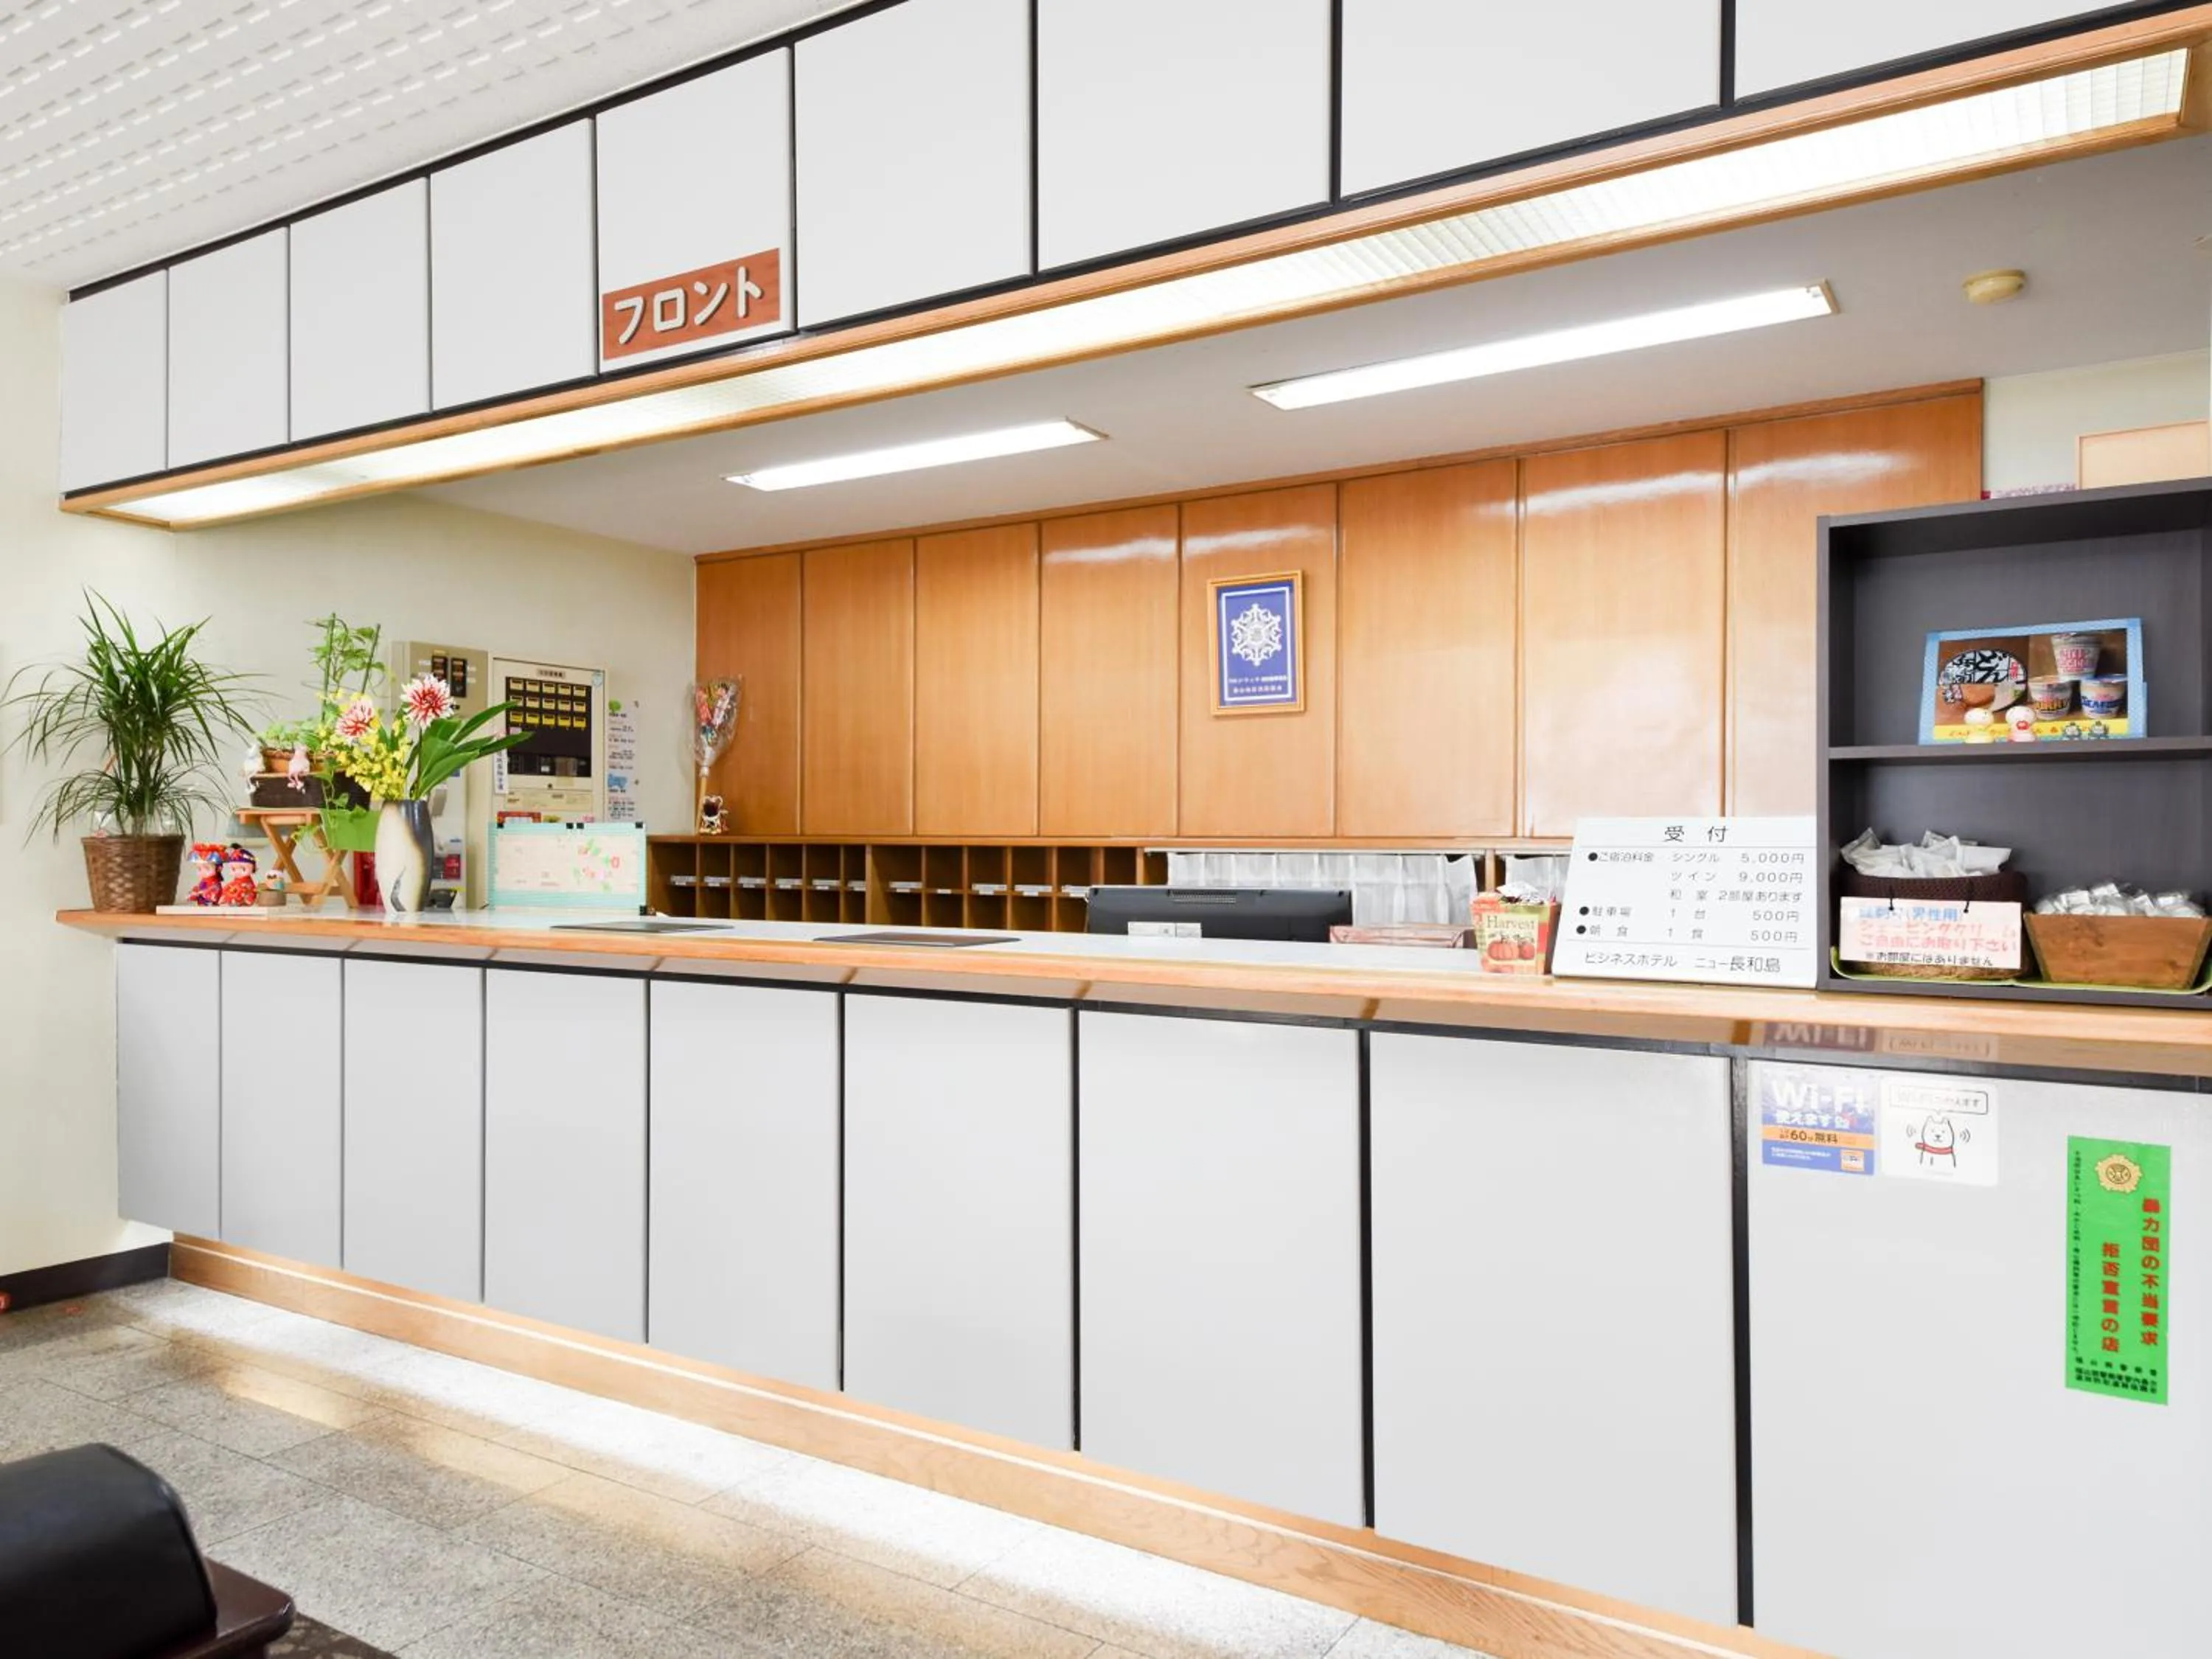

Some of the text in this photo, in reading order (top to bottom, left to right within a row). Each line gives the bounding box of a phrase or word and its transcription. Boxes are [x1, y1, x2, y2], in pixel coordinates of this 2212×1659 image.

[614, 266, 763, 344] フロント
[1672, 852, 1720, 863] シングル
[1487, 916, 1534, 930] Harvest
[1753, 910, 1800, 923] 500円
[1750, 930, 1798, 942] 500円
[1585, 953, 1781, 973] ビジネスホテル ニュー長和島
[1771, 1079, 1865, 1114] Wi-Fi
